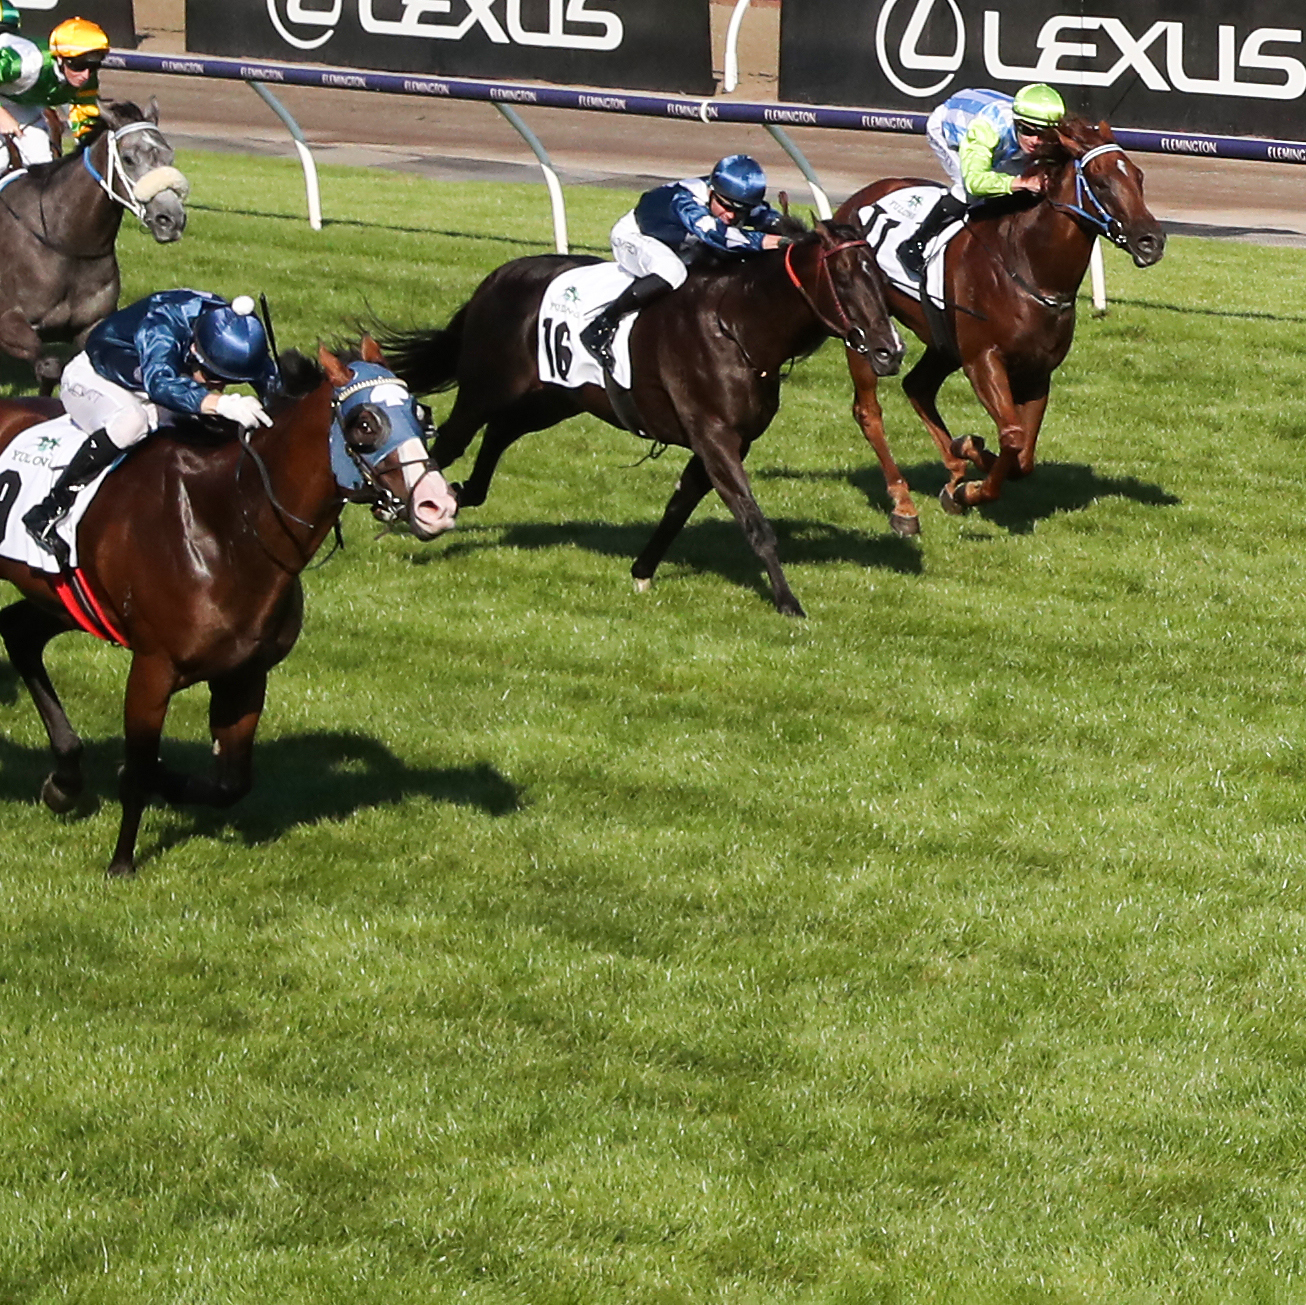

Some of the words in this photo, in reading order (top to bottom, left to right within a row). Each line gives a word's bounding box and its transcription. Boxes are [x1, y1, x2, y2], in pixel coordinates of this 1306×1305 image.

[764, 107, 817, 124] FLEMINGTON
[861, 114, 914, 131] FLEMINGTON
[1160, 137, 1218, 154] FLEMINGTON
[542, 317, 573, 382] 16
[11, 449, 52, 469] YULON
